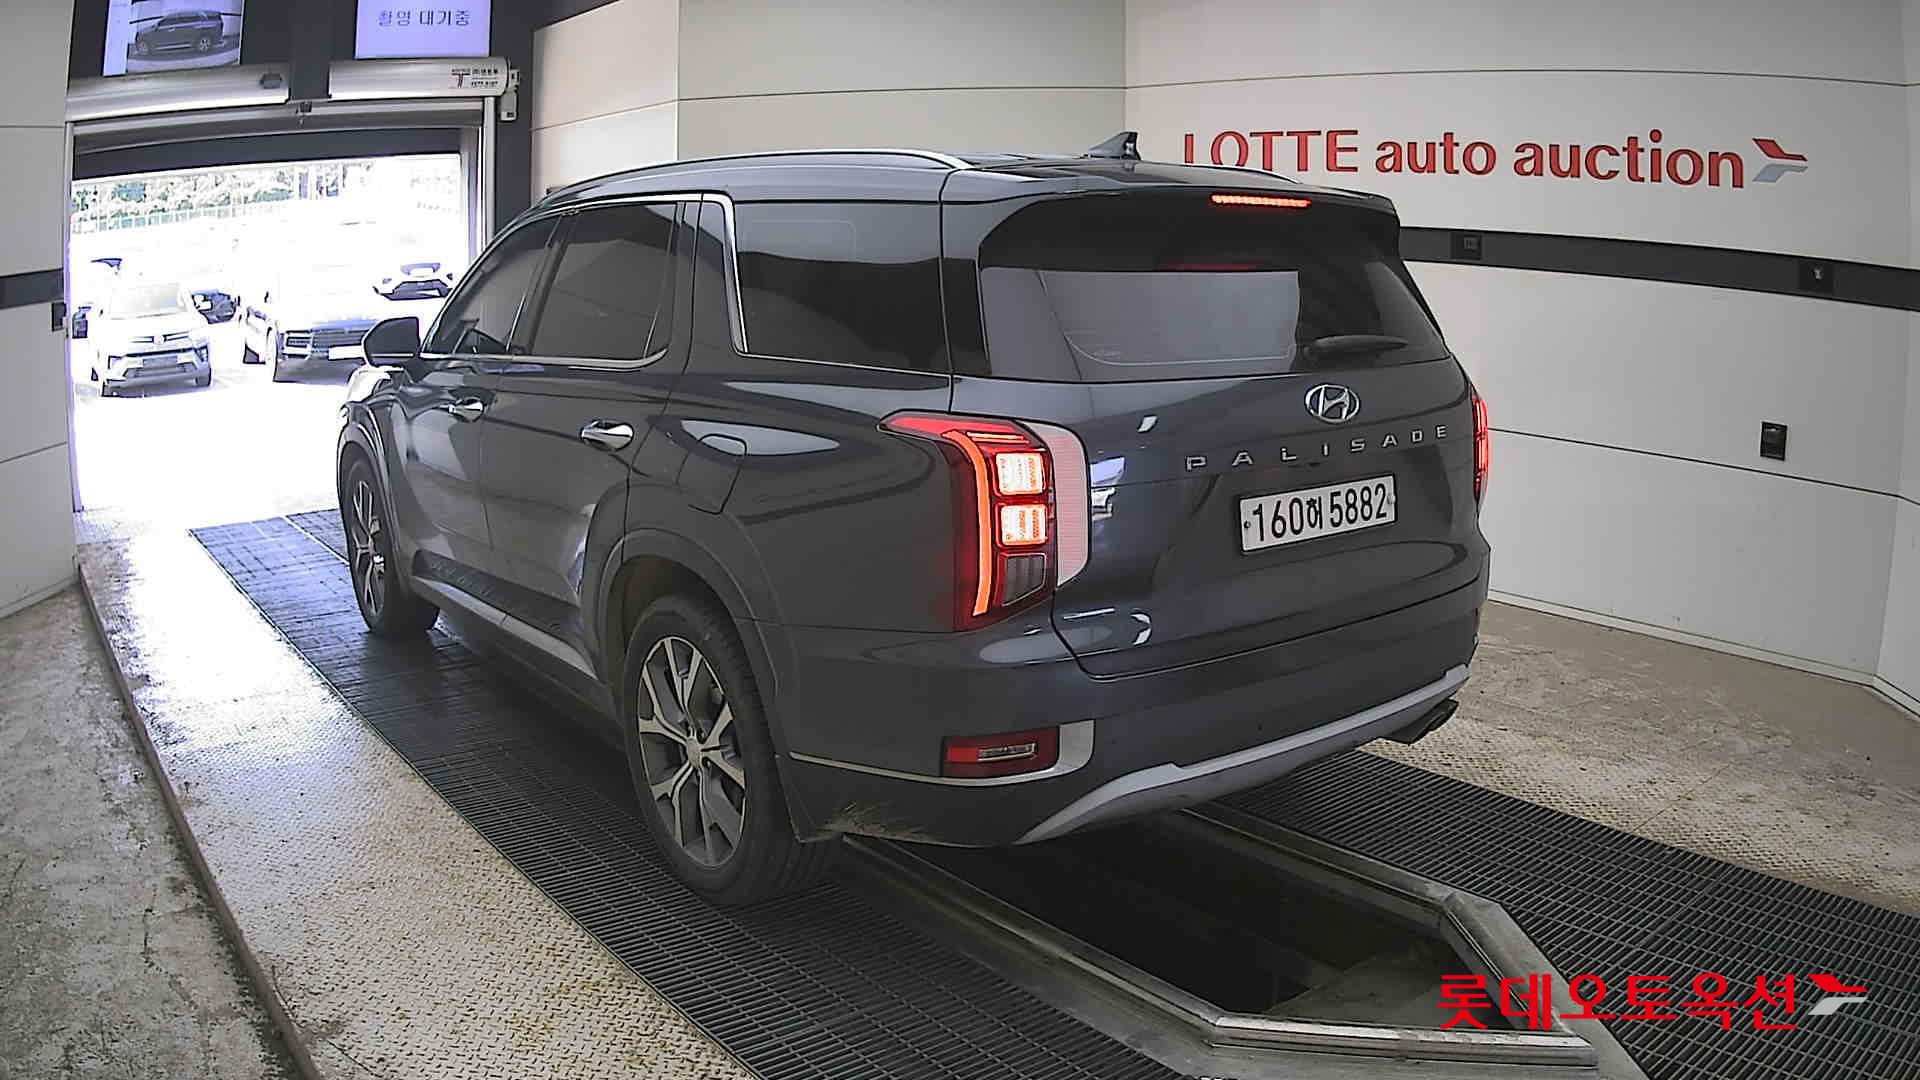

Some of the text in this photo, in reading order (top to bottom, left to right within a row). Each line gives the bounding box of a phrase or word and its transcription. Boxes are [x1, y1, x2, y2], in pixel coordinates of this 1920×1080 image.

[419, 10, 470, 26] 대기중
[1376, 132, 1498, 175] auto
[1513, 130, 1745, 188] auction
[1185, 424, 1448, 472] PALISADE
